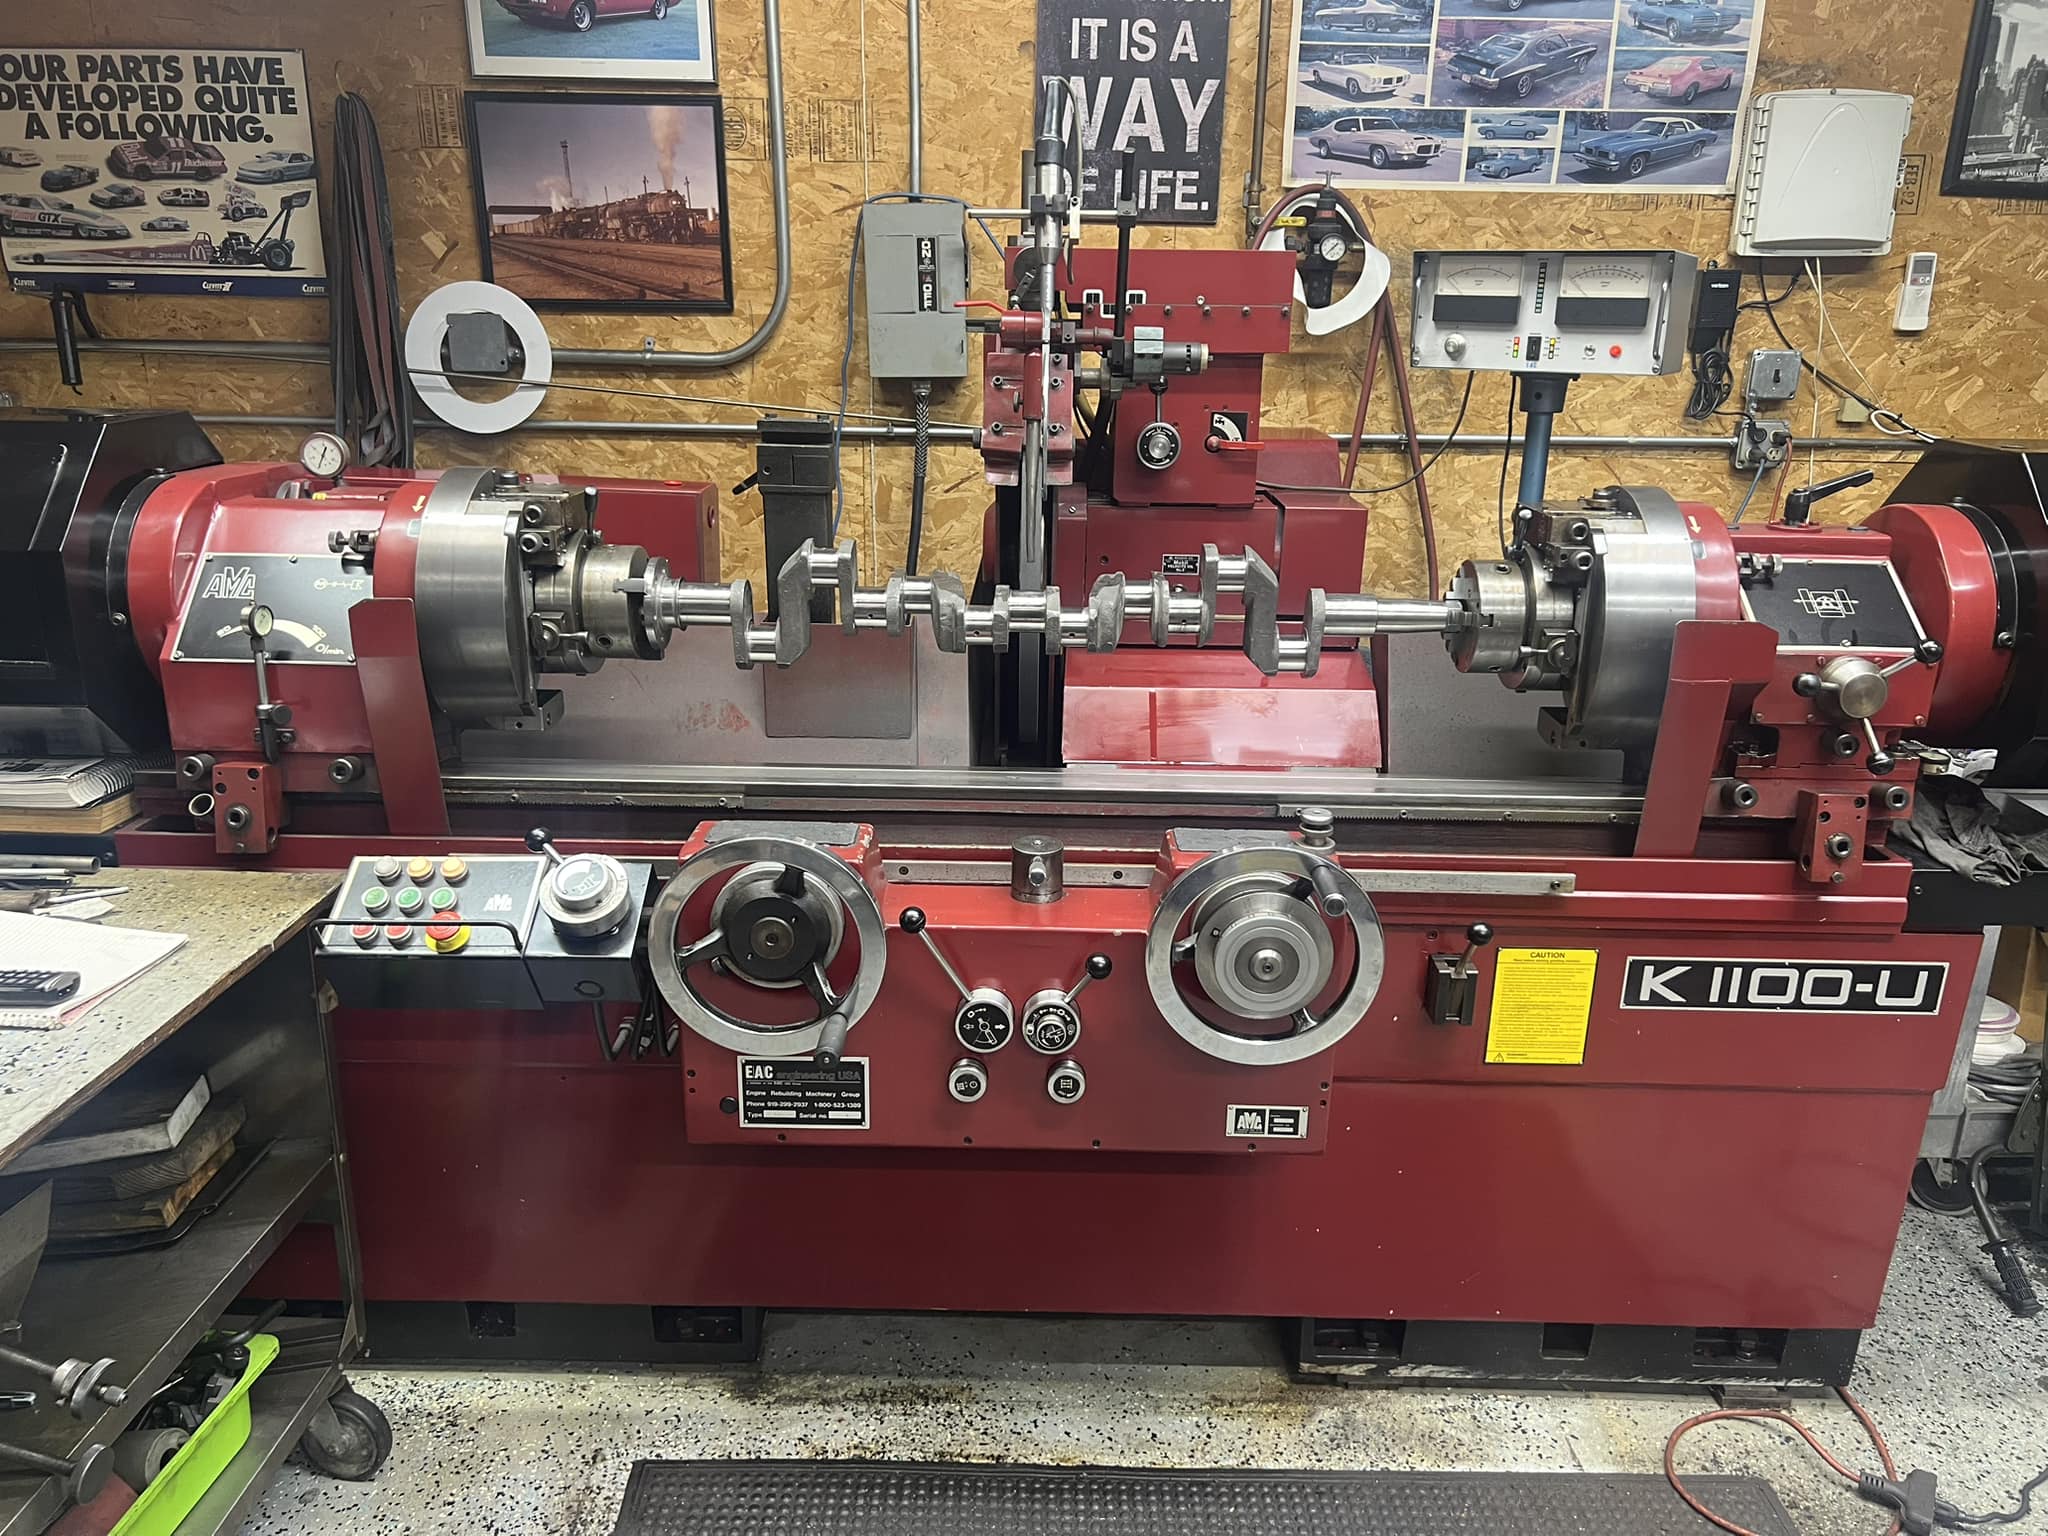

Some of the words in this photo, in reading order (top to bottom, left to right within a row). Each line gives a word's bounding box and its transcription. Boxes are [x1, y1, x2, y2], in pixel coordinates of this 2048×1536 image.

[1071, 18, 1108, 59] IT
[1119, 18, 1157, 62] IS
[1169, 20, 1199, 62] A
[0, 54, 67, 82] OUR
[77, 54, 184, 83] PARTS
[193, 56, 286, 86] HAVE
[0, 83, 183, 112] DEVELOPED
[194, 85, 298, 115] QUITE
[25, 113, 50, 140] A
[56, 113, 274, 144] FOLLOWING.
[38, 212, 62, 224] GTX
[921, 240, 932, 258] ON
[923, 283, 933, 309] OFF
[1530, 951, 1566, 959] CAUTION
[1639, 965, 1692, 1002] K
[1708, 966, 1929, 1007] 1100-U
[745, 1065, 773, 1079] EAC
[837, 1071, 861, 1080] USA
